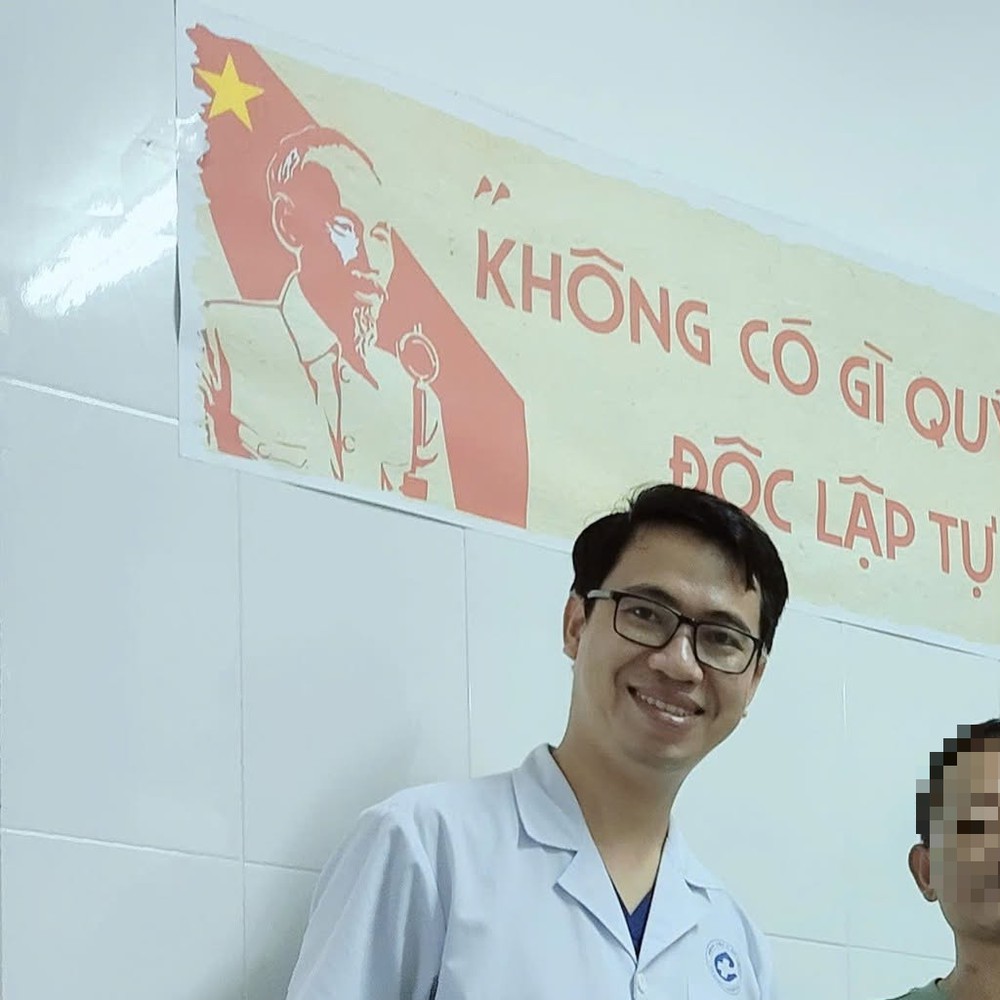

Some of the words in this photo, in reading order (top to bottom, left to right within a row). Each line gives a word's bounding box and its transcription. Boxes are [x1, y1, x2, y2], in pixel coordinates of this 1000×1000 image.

[739, 318, 819, 395] CÓ
[840, 341, 893, 423] GÌ
[816, 475, 915, 569] LẬP
[929, 511, 996, 598] TỰ
